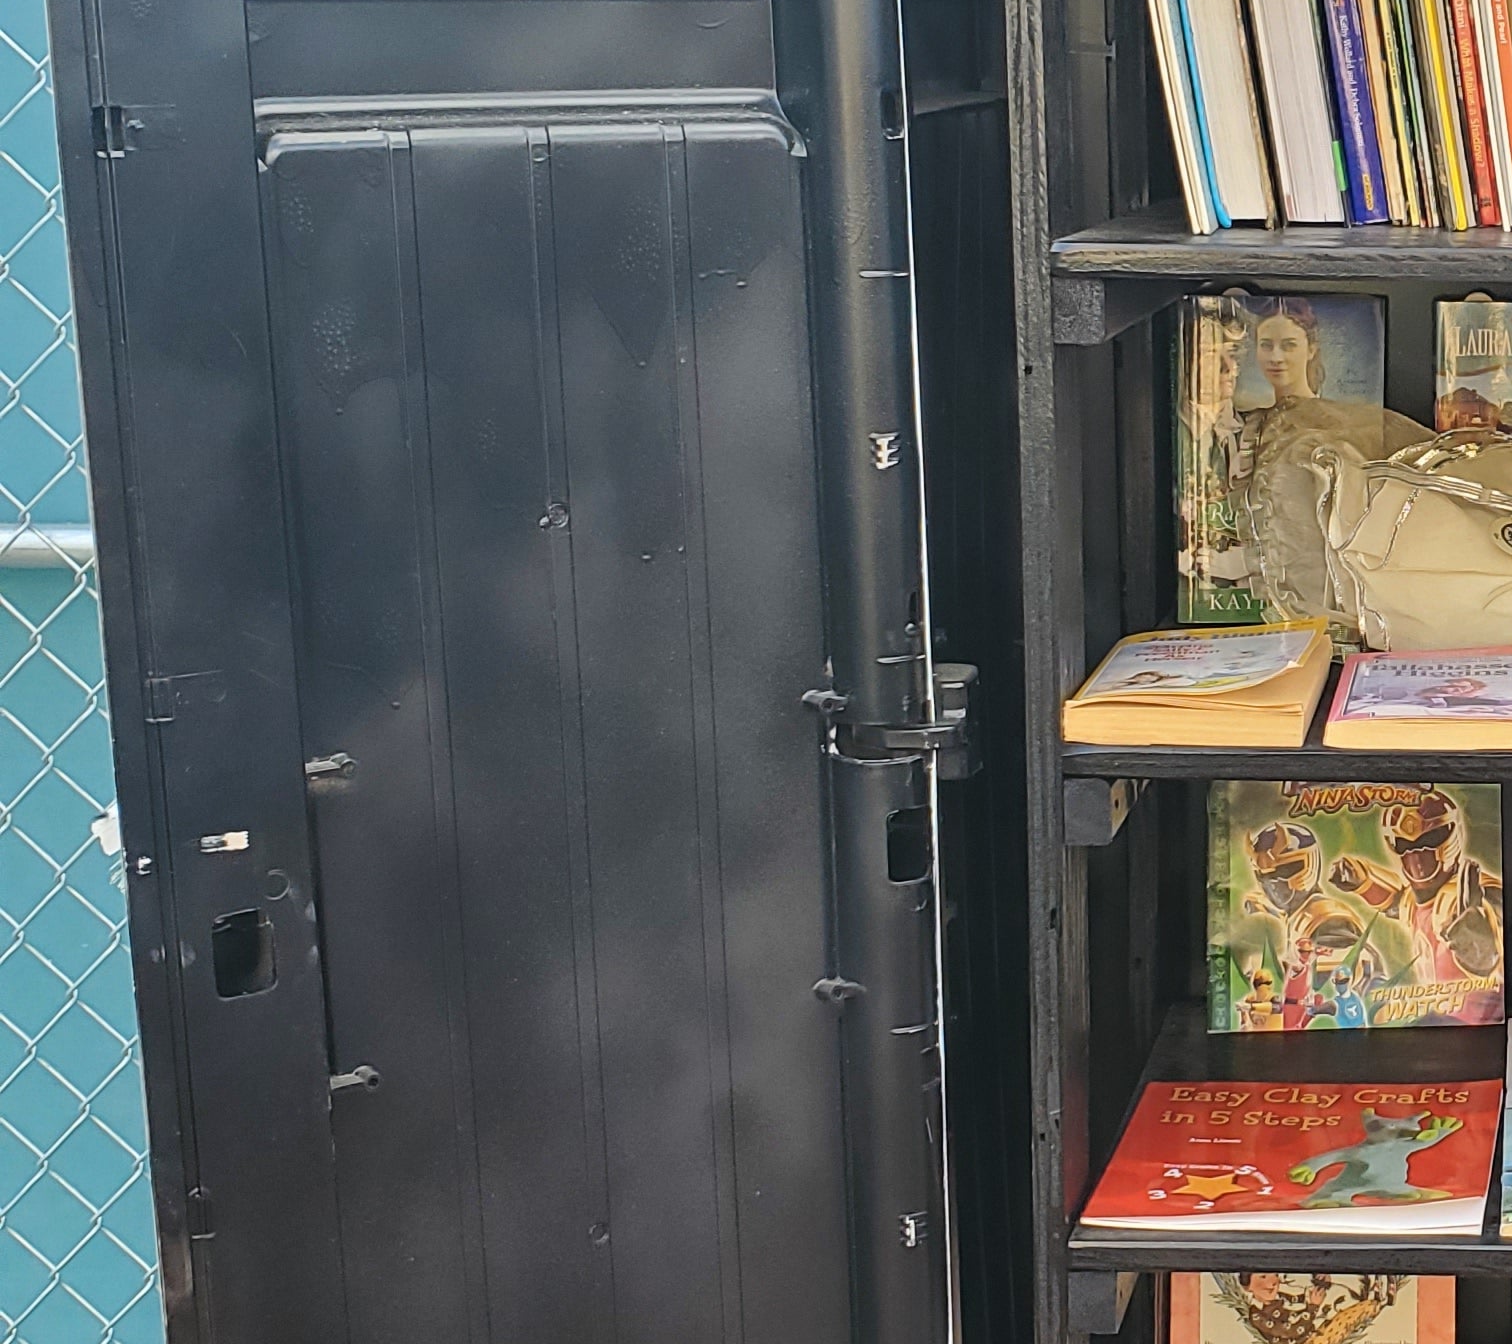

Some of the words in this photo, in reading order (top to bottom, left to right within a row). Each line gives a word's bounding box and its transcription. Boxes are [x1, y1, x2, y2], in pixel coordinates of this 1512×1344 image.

[1495, 4, 1504, 20] and
[1497, 20, 1508, 45] Pearl
[1296, 786, 1355, 814] NINJA
[1354, 784, 1421, 808] STORM
[1370, 976, 1499, 1003] THUNDERSTORM
[1384, 996, 1469, 1025] WATCH
[1169, 1087, 1251, 1107] Easy
[1263, 1087, 1342, 1107] Clay
[1353, 1088, 1470, 1105] Crafts
[1160, 1110, 1196, 1125] in
[1208, 1110, 1232, 1126] 5
[1242, 1110, 1343, 1131] Steps
